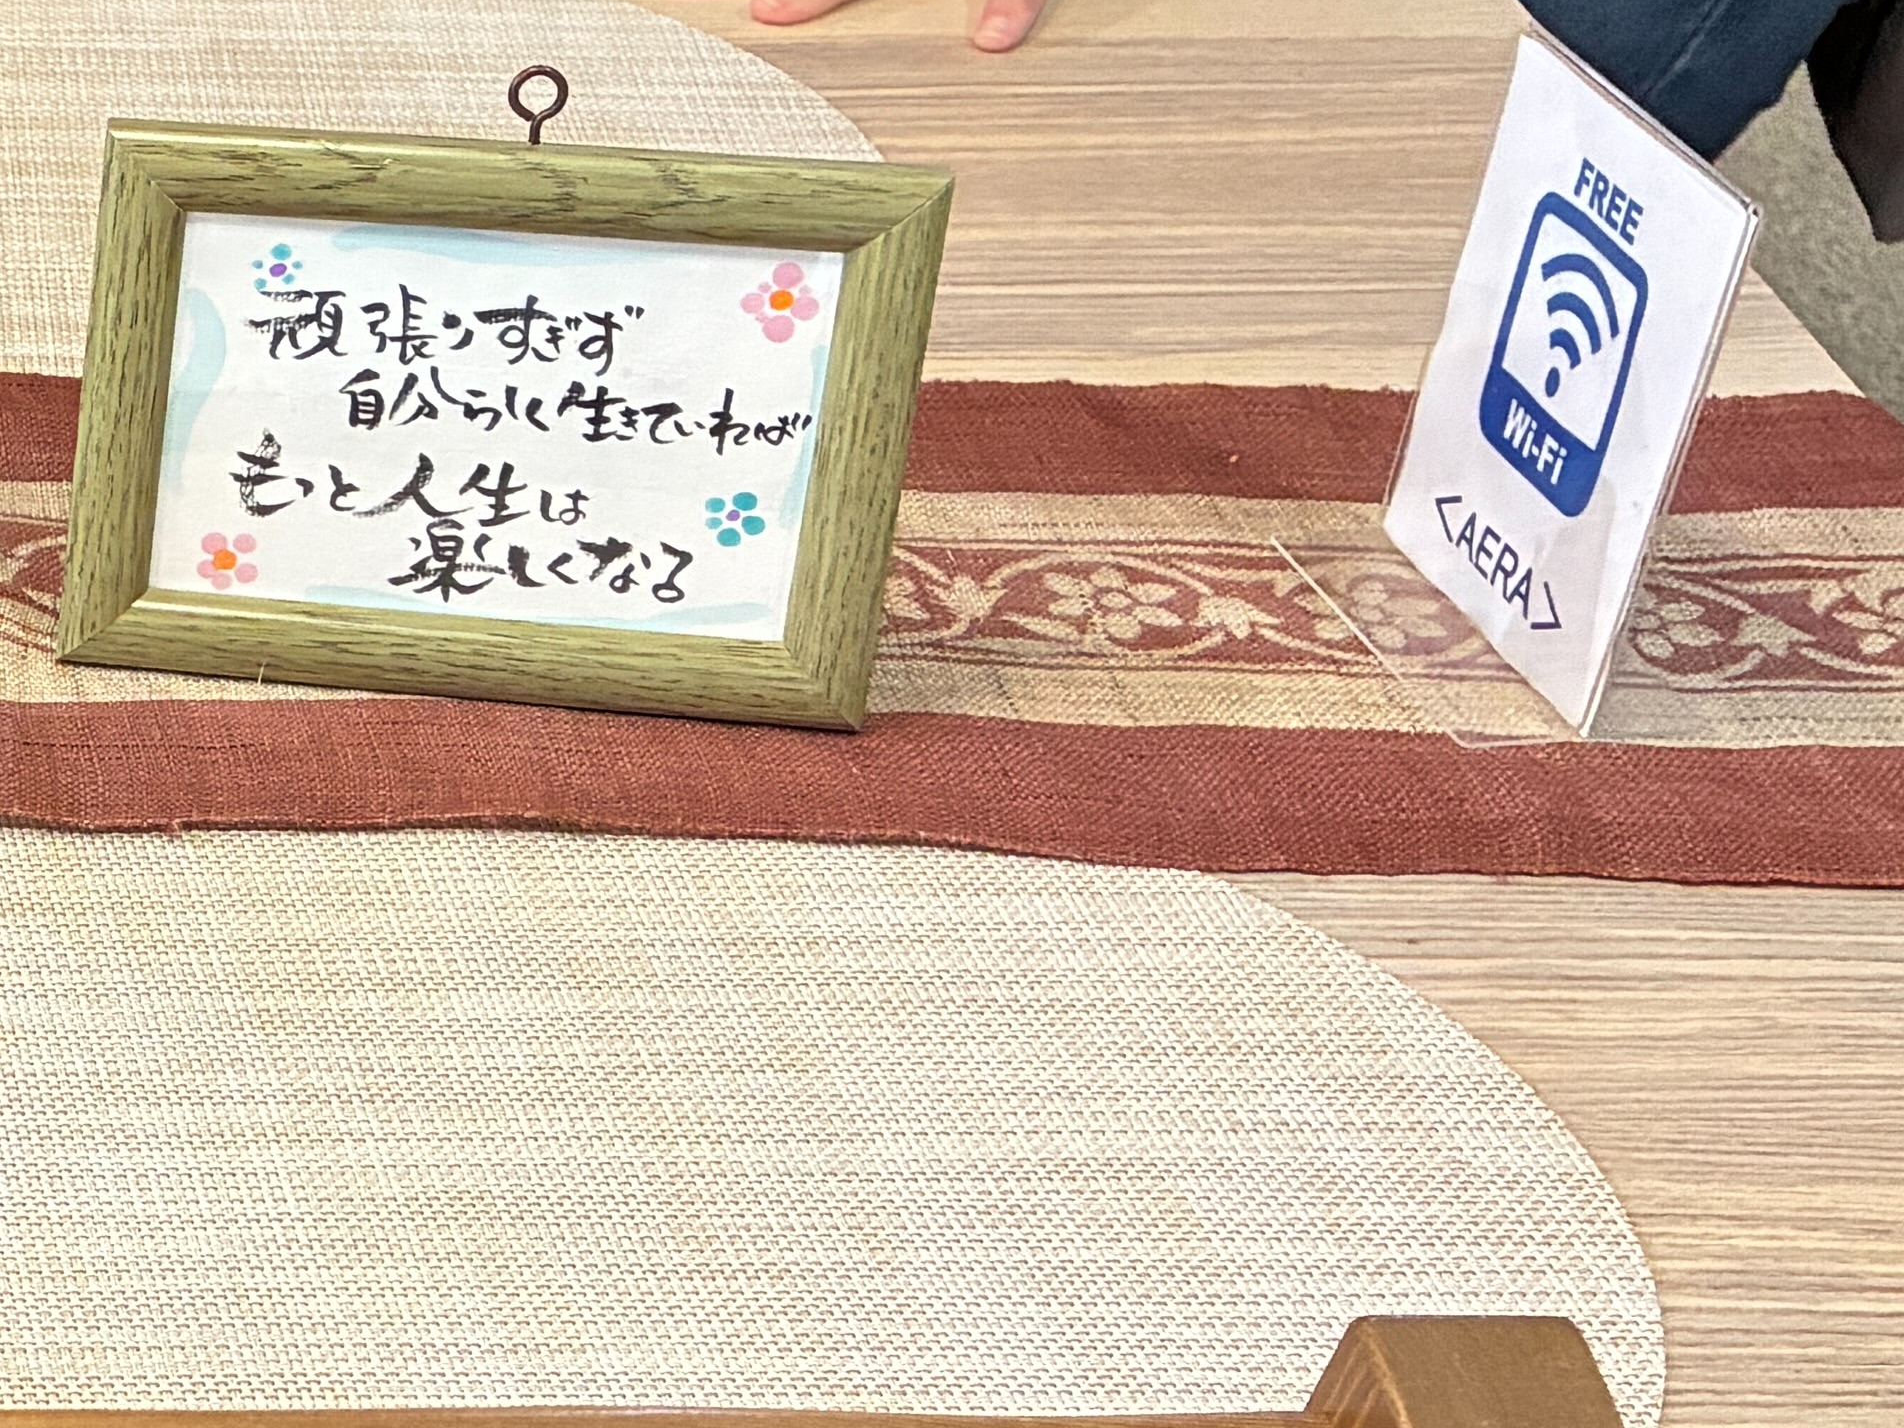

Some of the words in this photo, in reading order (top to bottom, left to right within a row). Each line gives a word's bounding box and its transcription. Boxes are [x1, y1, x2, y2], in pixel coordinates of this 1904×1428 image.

[1573, 156, 1645, 247] FREE
[248, 283, 646, 377] 頑張りすぎず
[339, 365, 815, 456] 自分らしく生きていれば
[1501, 397, 1569, 486] Wi-Fi
[229, 426, 591, 528] もっと人生は
[386, 518, 694, 604] 楽しくなる
